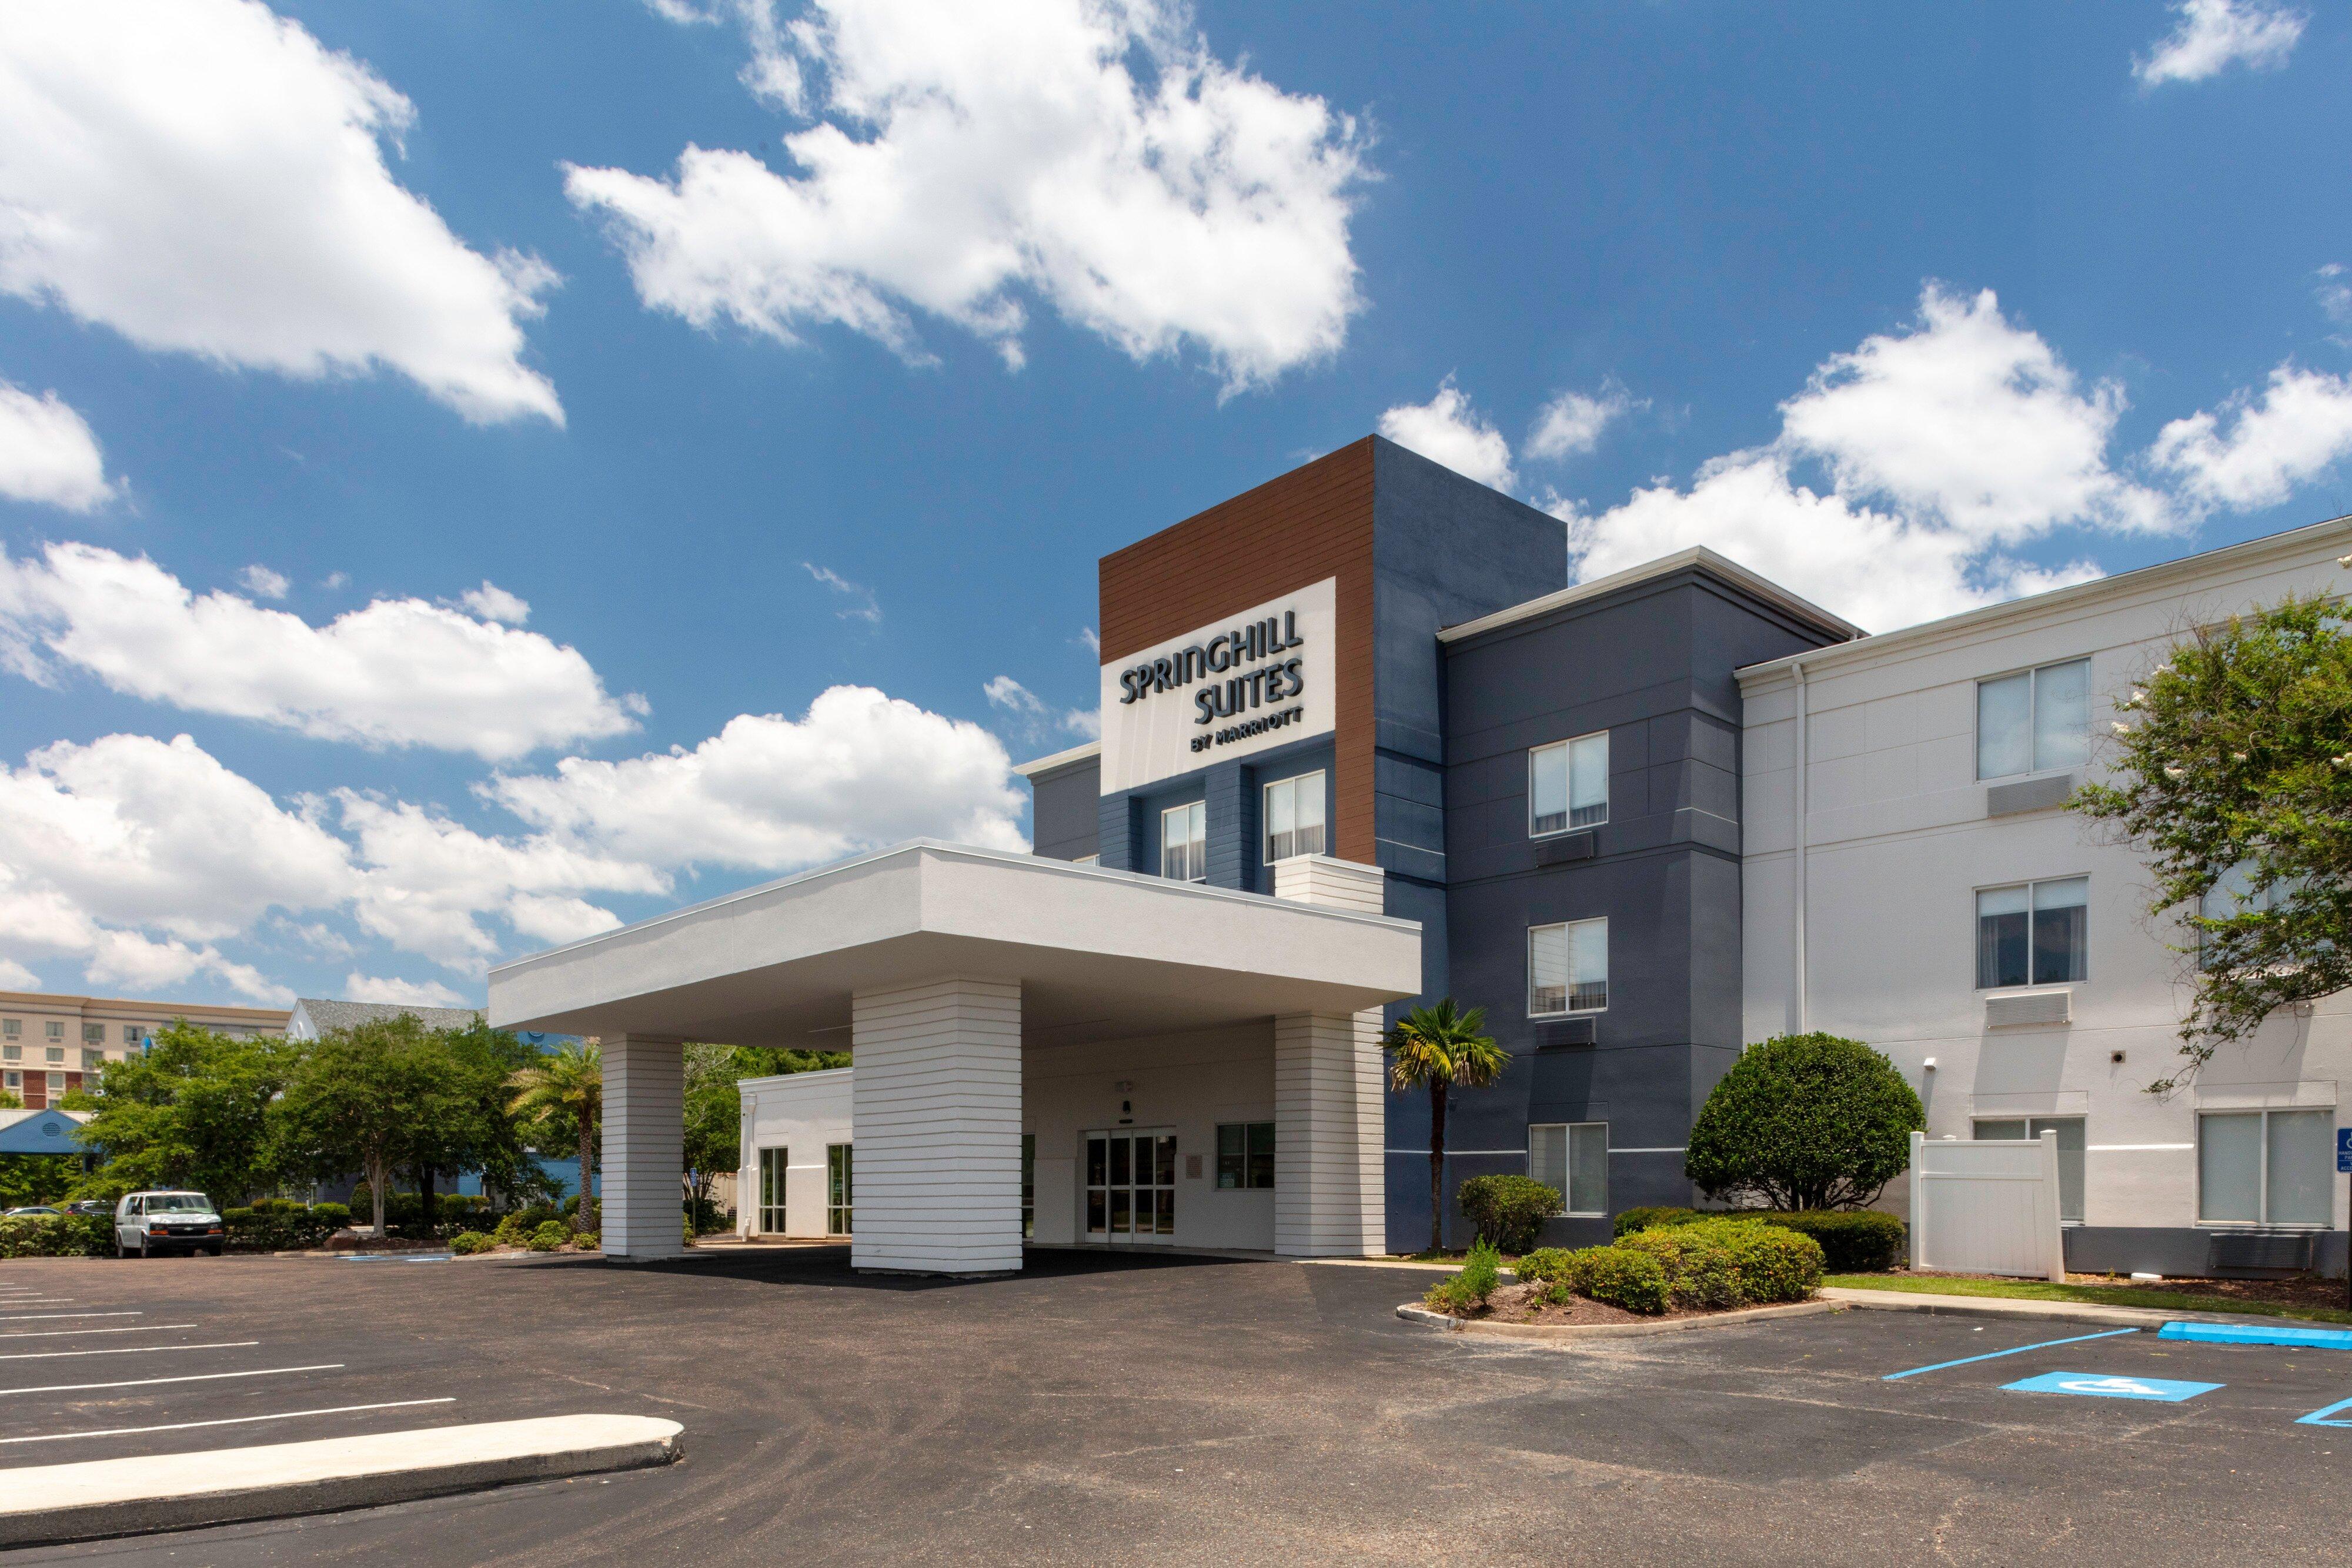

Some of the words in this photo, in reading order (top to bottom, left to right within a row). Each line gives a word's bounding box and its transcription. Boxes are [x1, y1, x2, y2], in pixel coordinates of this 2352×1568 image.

[1120, 610, 1304, 704] SPRINGHILL
[1195, 658, 1303, 724] SUITES
[1191, 734, 1214, 753] BY
[1215, 706, 1304, 745] MARRIOTT
